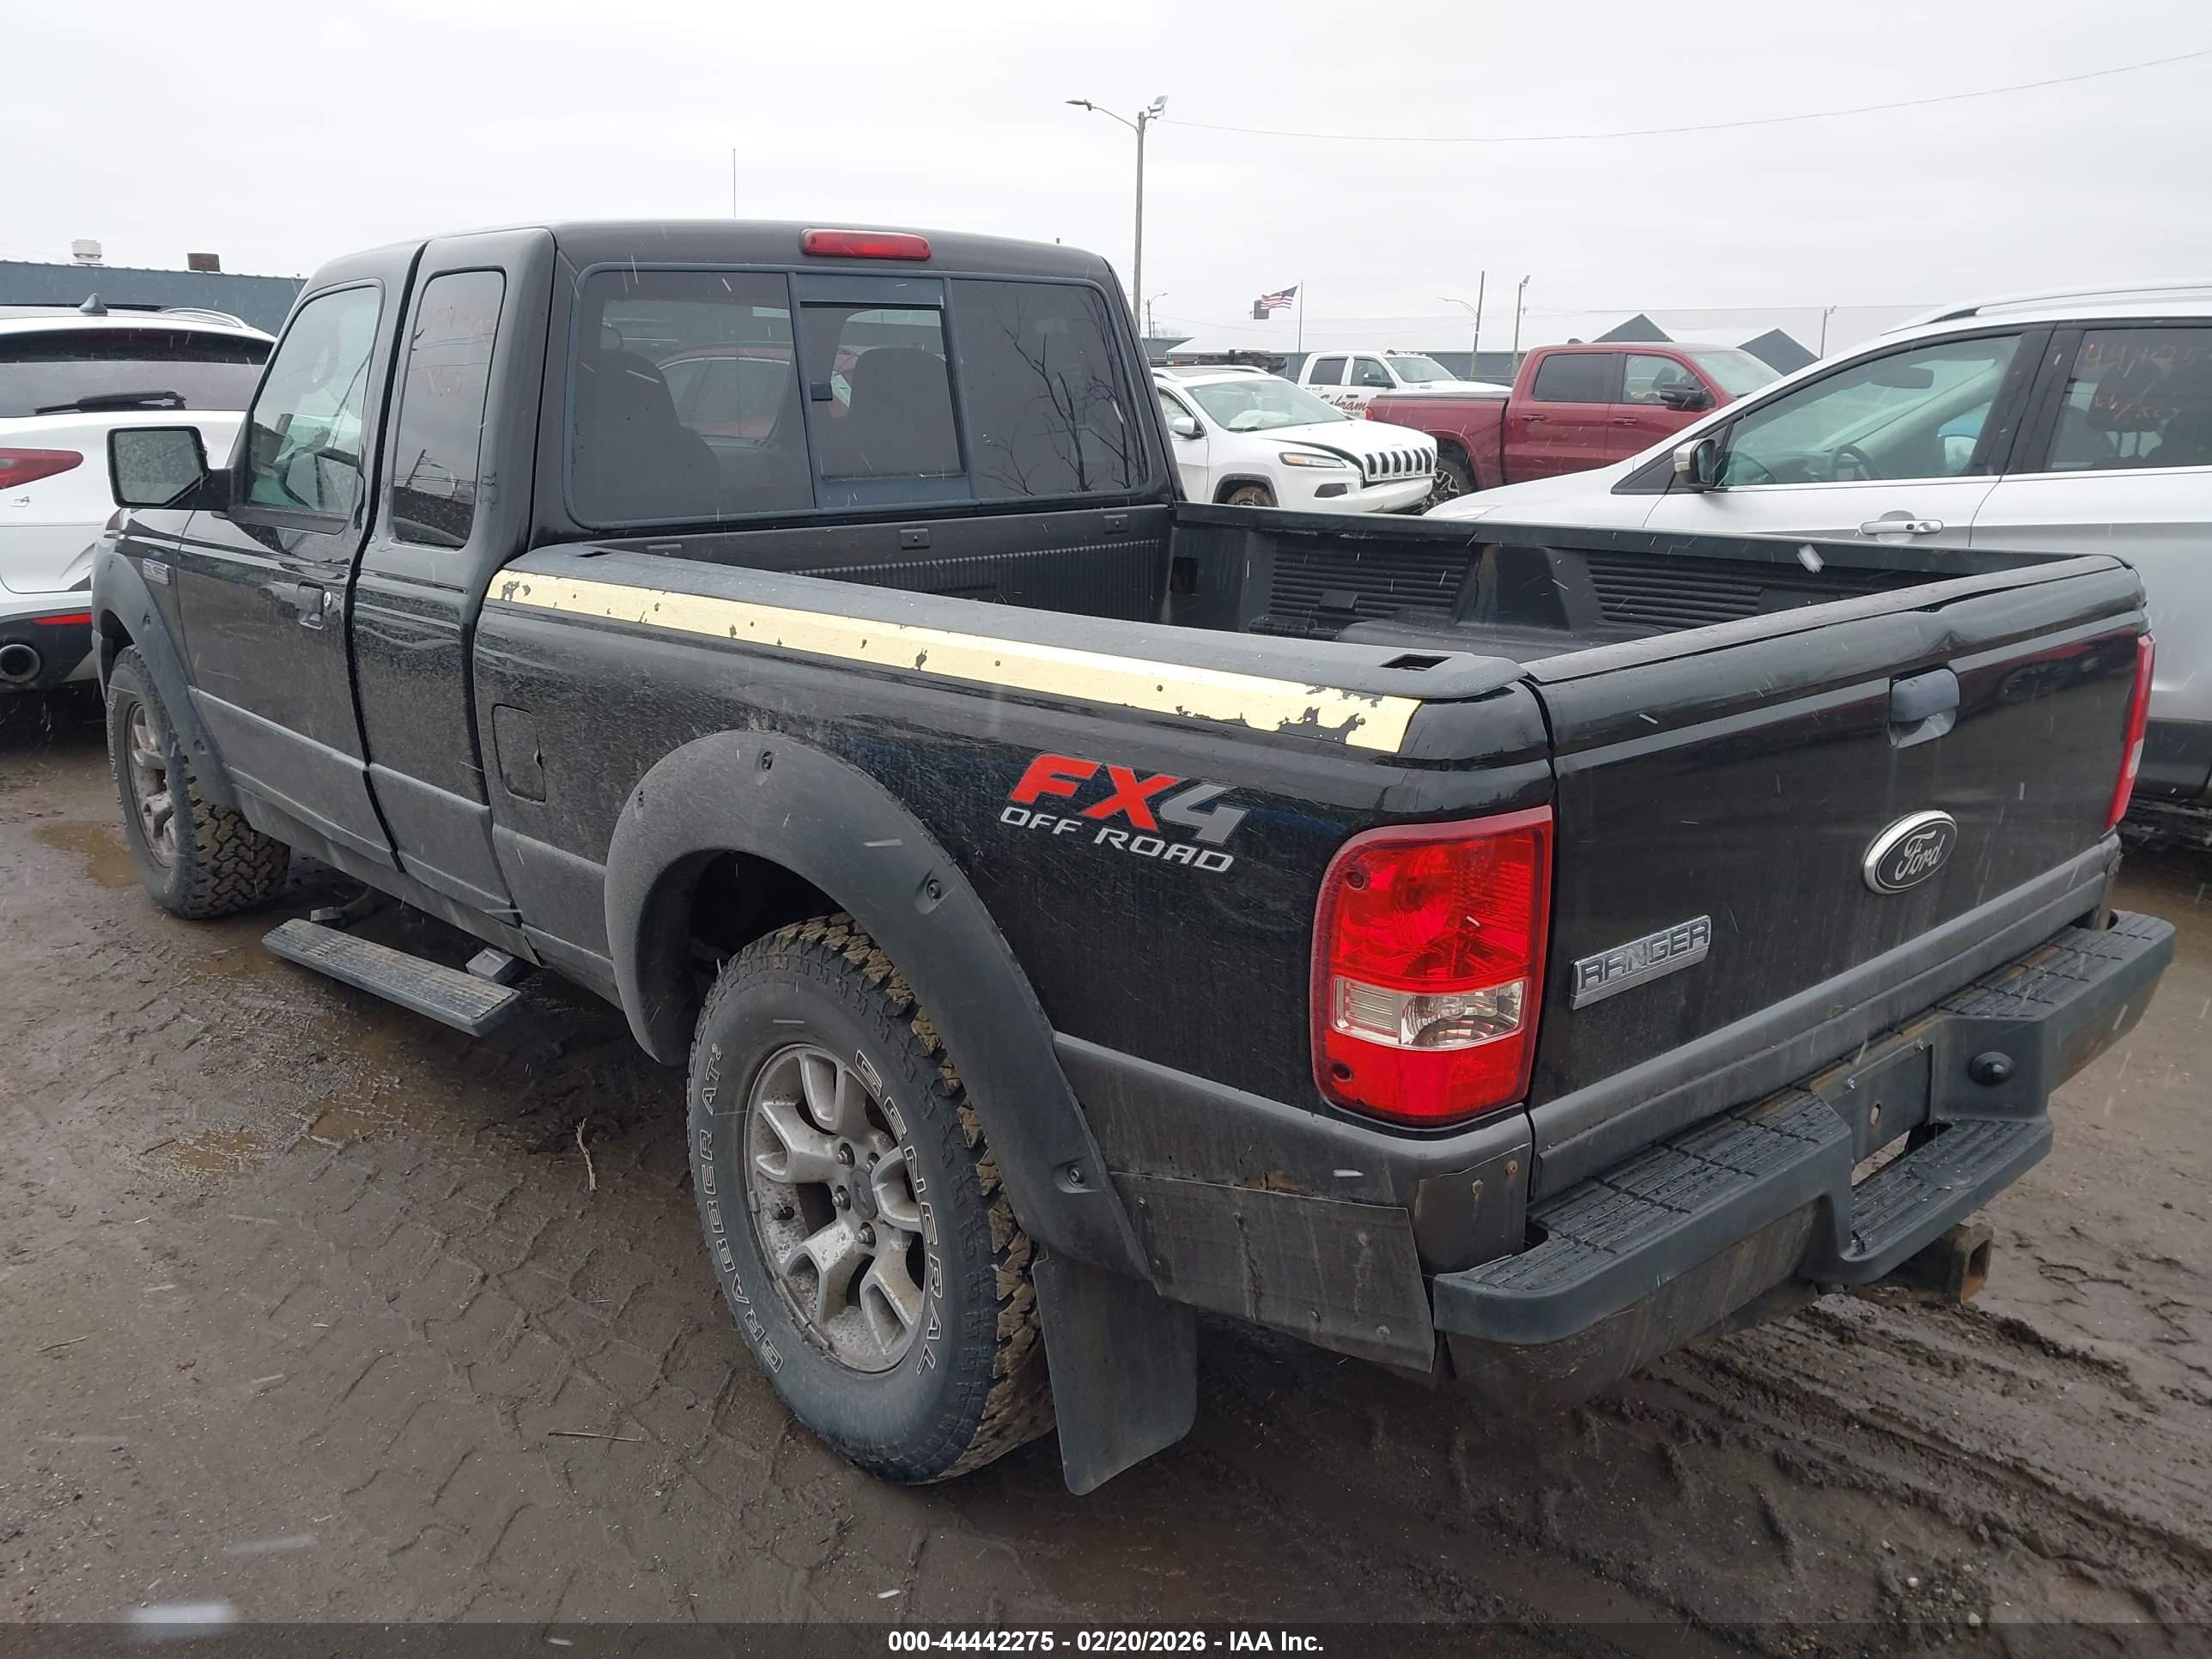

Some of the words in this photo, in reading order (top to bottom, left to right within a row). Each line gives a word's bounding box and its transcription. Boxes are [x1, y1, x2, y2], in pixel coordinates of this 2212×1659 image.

[1320, 394, 1367, 410] hram
[1008, 750, 1250, 847] FX4
[999, 805, 1084, 836] OFF
[1093, 826, 1236, 874] ROAD
[1894, 828, 1947, 882] Ford
[1579, 920, 1711, 992] RANGER
[854, 1049, 943, 1376] GENERAL
[700, 1128, 783, 1374] GRABBER
